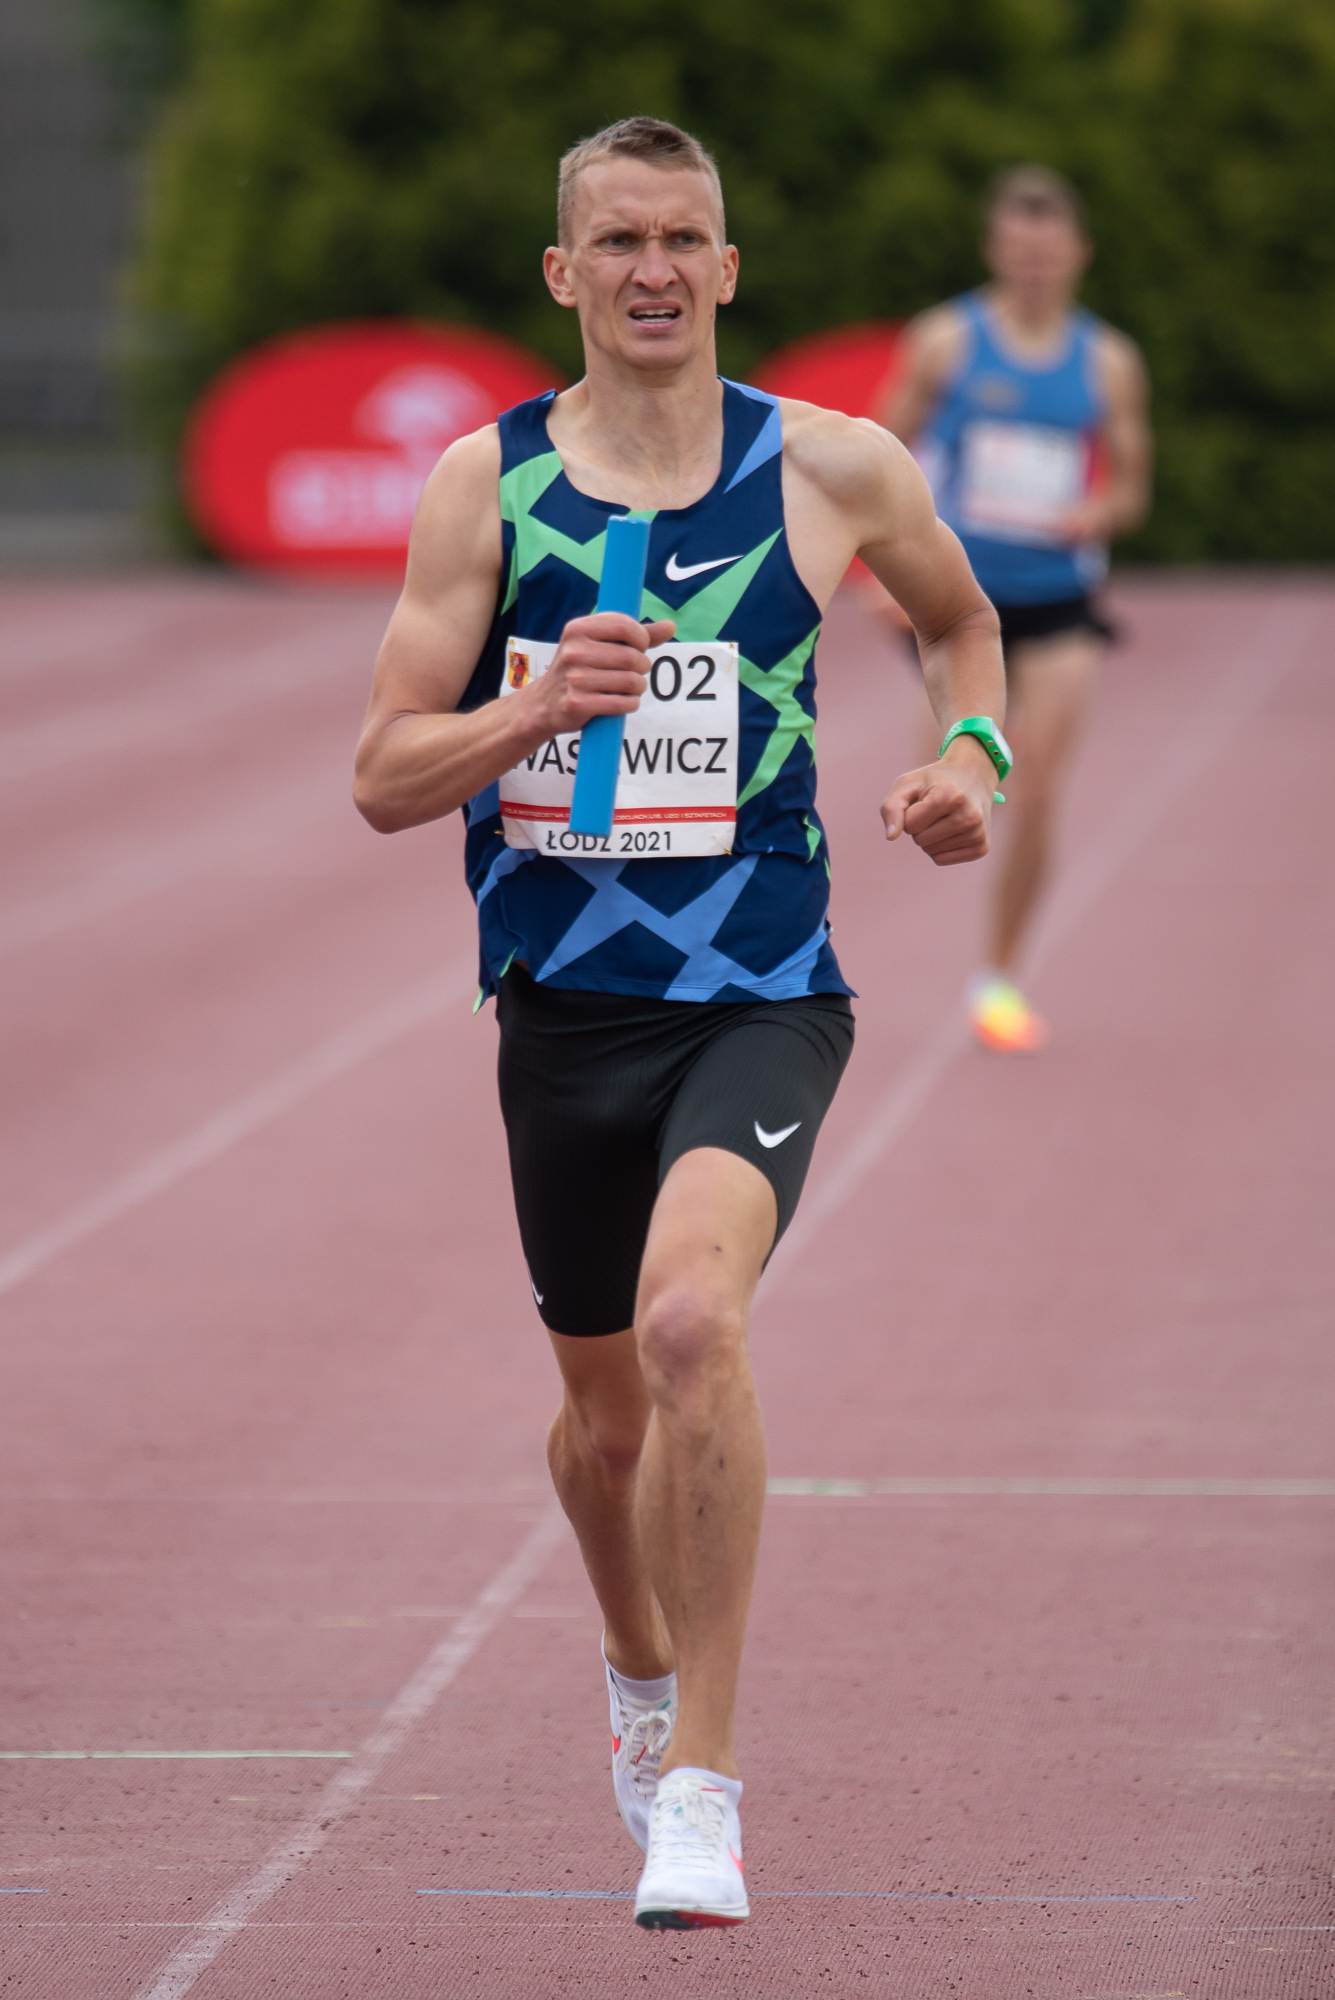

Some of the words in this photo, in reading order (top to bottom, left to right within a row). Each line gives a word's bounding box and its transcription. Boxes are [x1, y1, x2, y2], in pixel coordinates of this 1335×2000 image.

[650, 654, 717, 703] 02
[511, 736, 728, 776] ASWICZ
[619, 831, 671, 852] 2021
